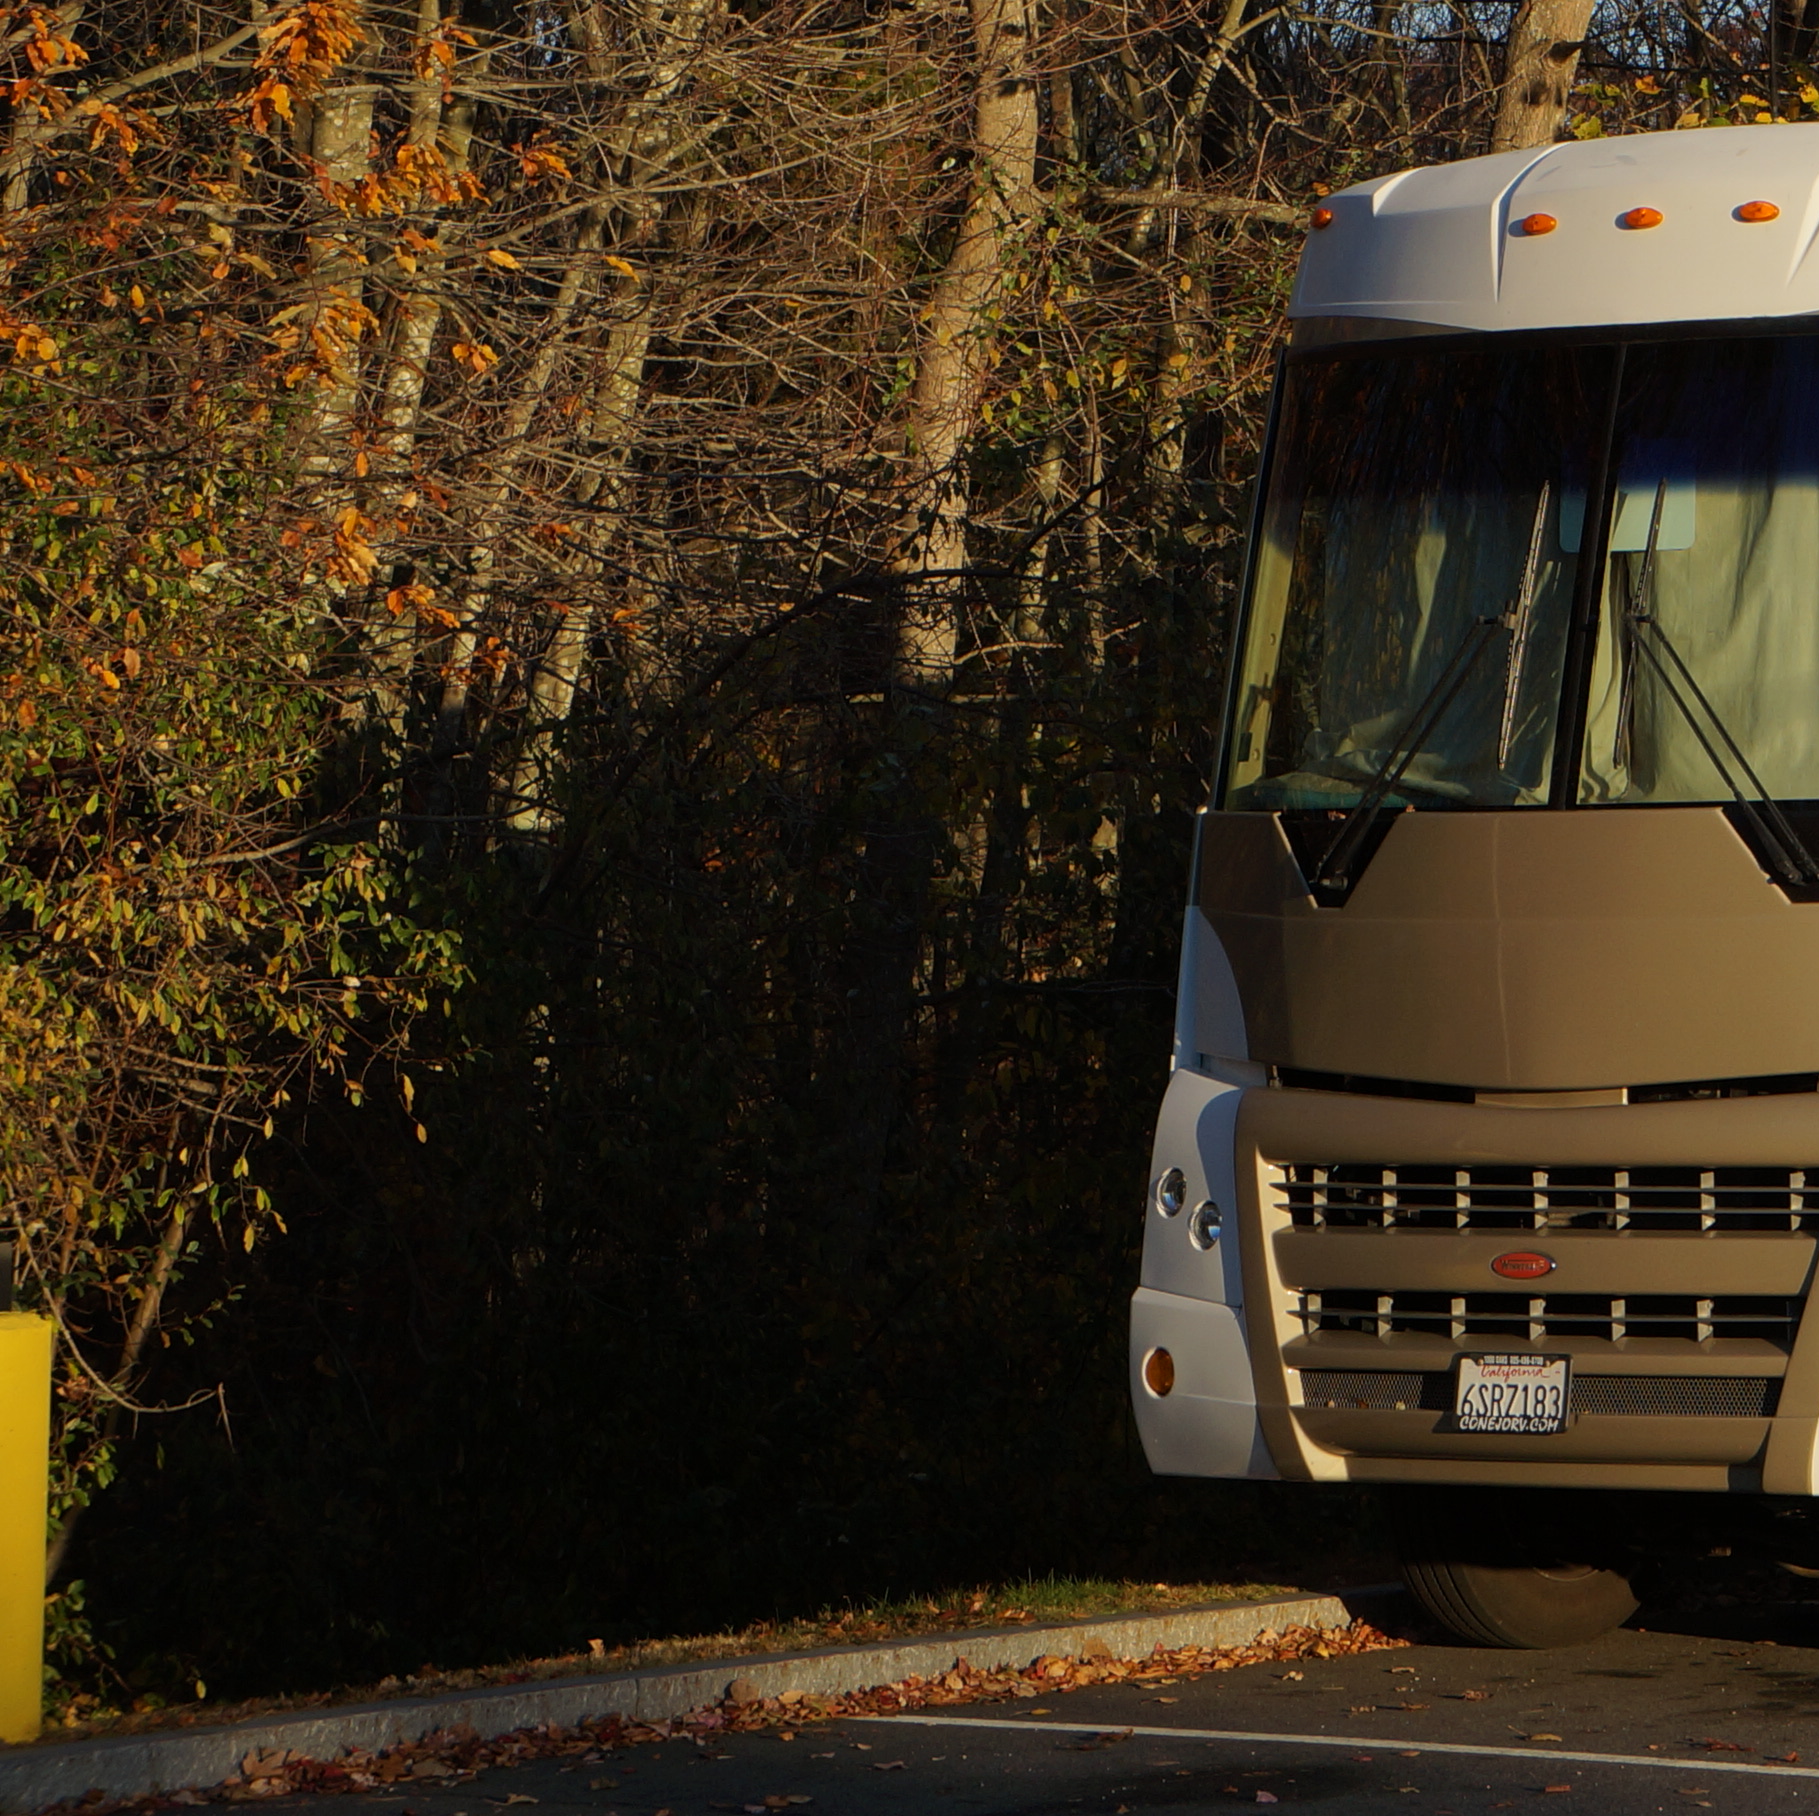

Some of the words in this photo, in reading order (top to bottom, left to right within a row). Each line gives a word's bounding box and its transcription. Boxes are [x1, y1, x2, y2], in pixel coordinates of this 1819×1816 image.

[1481, 1365, 1550, 1383] California
[1461, 1384, 1561, 1418] 6SRZ183
[1459, 1416, 1559, 1432] CONEJORV.COM
